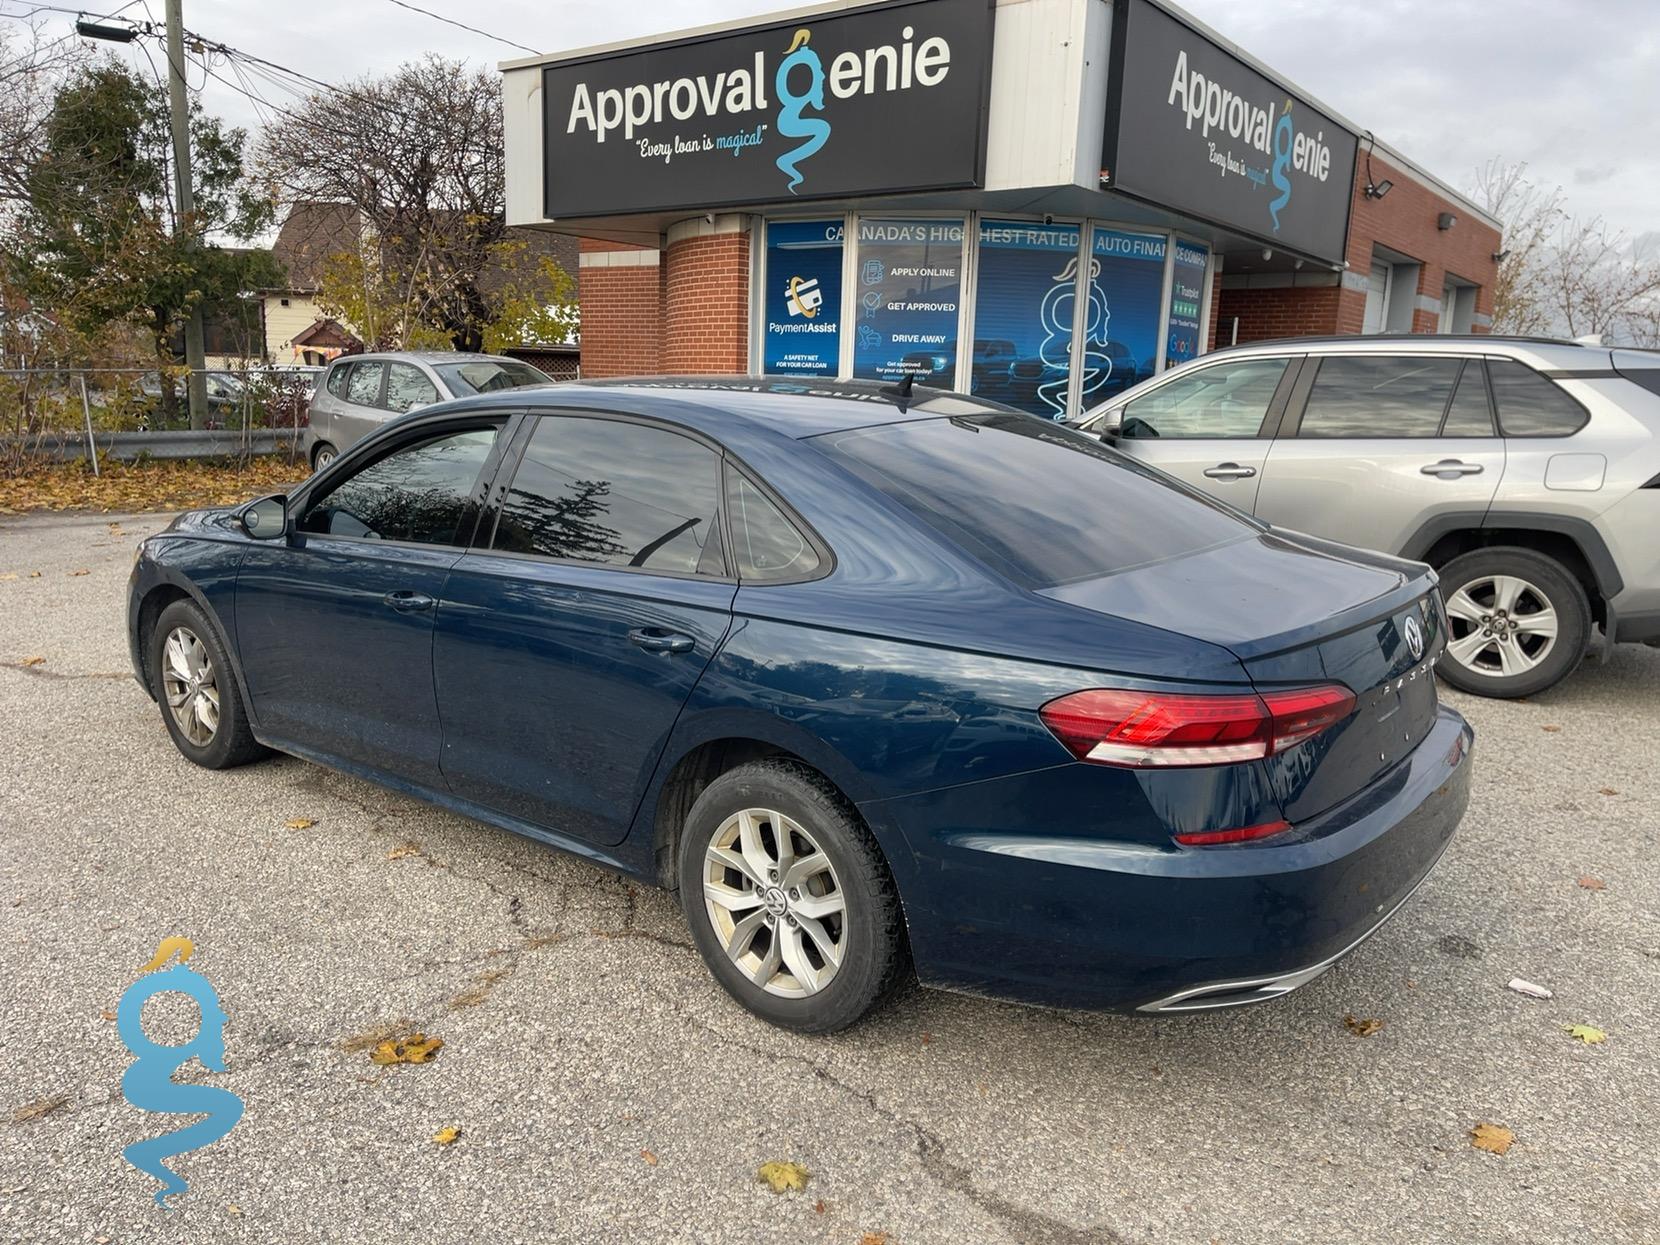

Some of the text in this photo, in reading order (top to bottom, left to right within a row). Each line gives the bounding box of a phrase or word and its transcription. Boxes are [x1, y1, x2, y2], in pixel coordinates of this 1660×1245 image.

[567, 51, 768, 142] Approval
[1168, 50, 1275, 155] Approval
[675, 135, 700, 154] loan
[702, 134, 714, 151] is
[1027, 230, 1080, 247] RATED
[1096, 236, 1132, 253] AUTO
[891, 268, 955, 277] APPLY ONLINE
[887, 302, 956, 312] GET APPROVED
[769, 323, 837, 335] PaymentAssist
[892, 334, 946, 343] DRIVE AWAY
